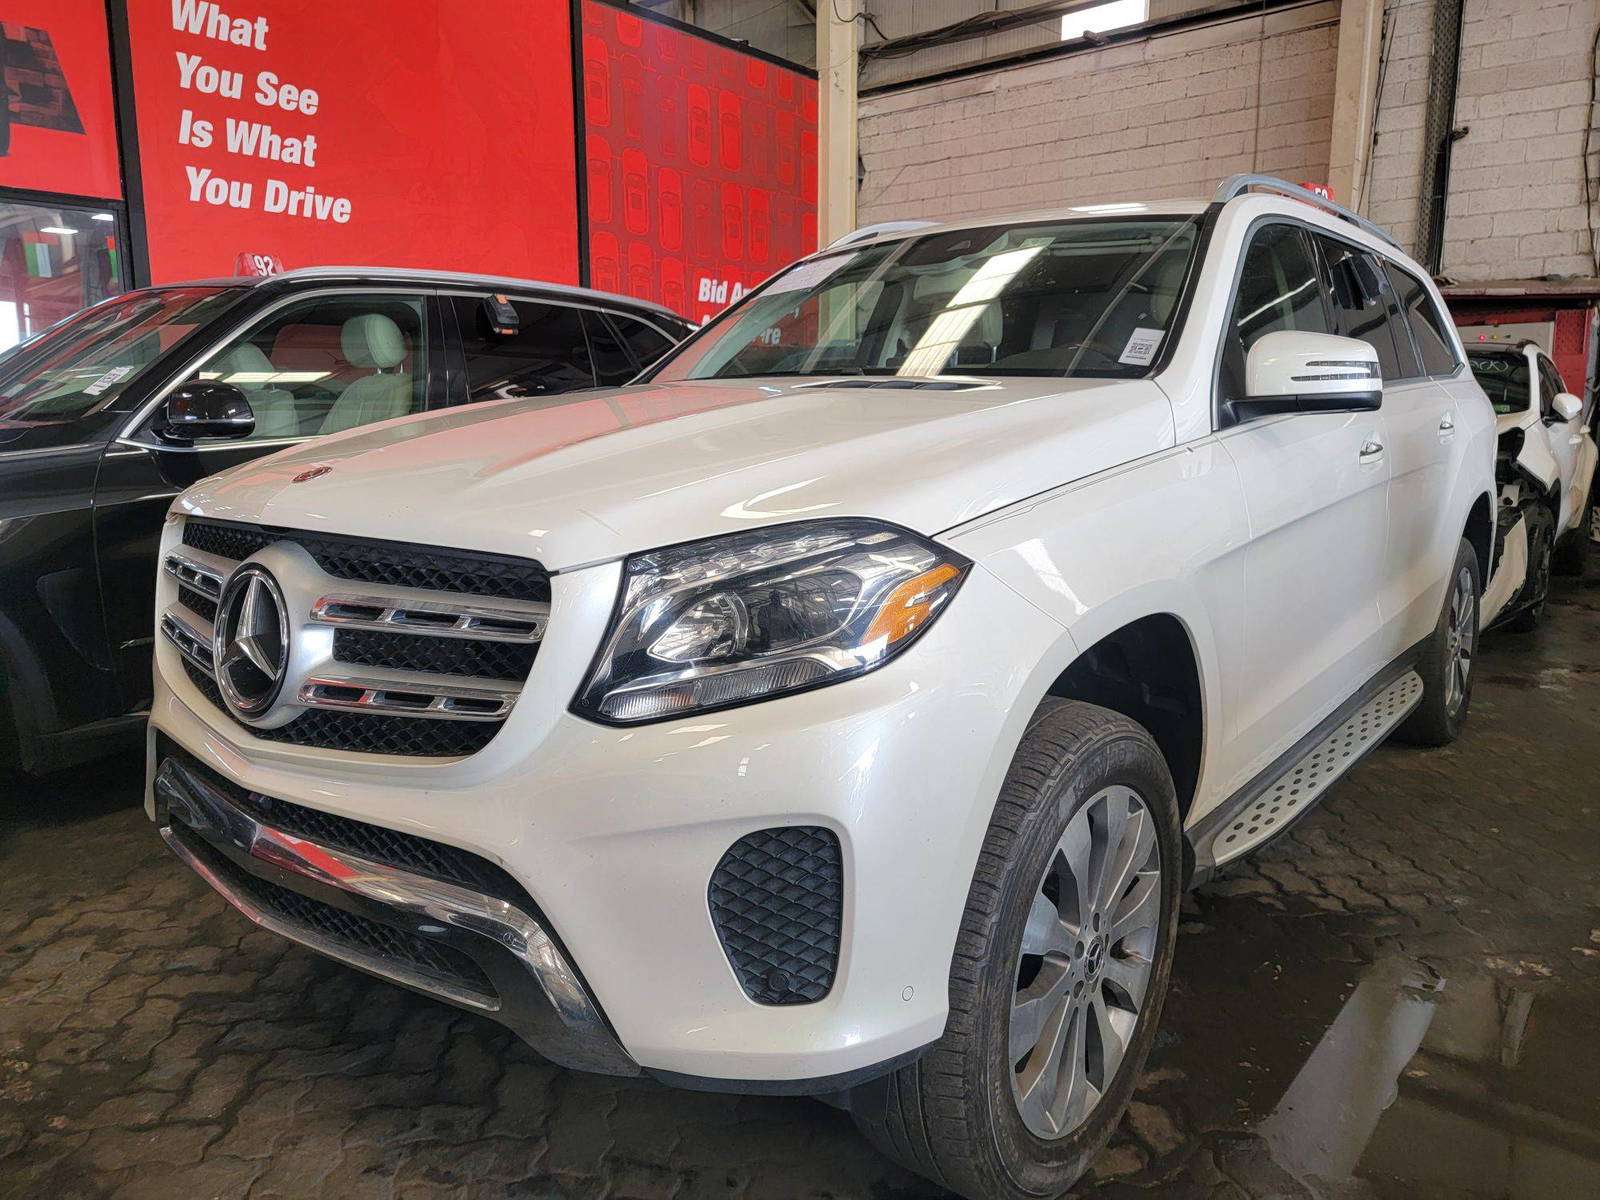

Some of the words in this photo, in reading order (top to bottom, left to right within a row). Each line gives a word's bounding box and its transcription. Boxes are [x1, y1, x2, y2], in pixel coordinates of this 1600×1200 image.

[171, 0, 269, 51] What
[175, 51, 243, 100] You
[254, 71, 319, 116] See
[178, 109, 214, 148] Is
[226, 117, 318, 168] What
[185, 165, 252, 209] You
[263, 178, 352, 224] Drive
[253, 255, 276, 277] 92
[698, 277, 729, 305] Bid
